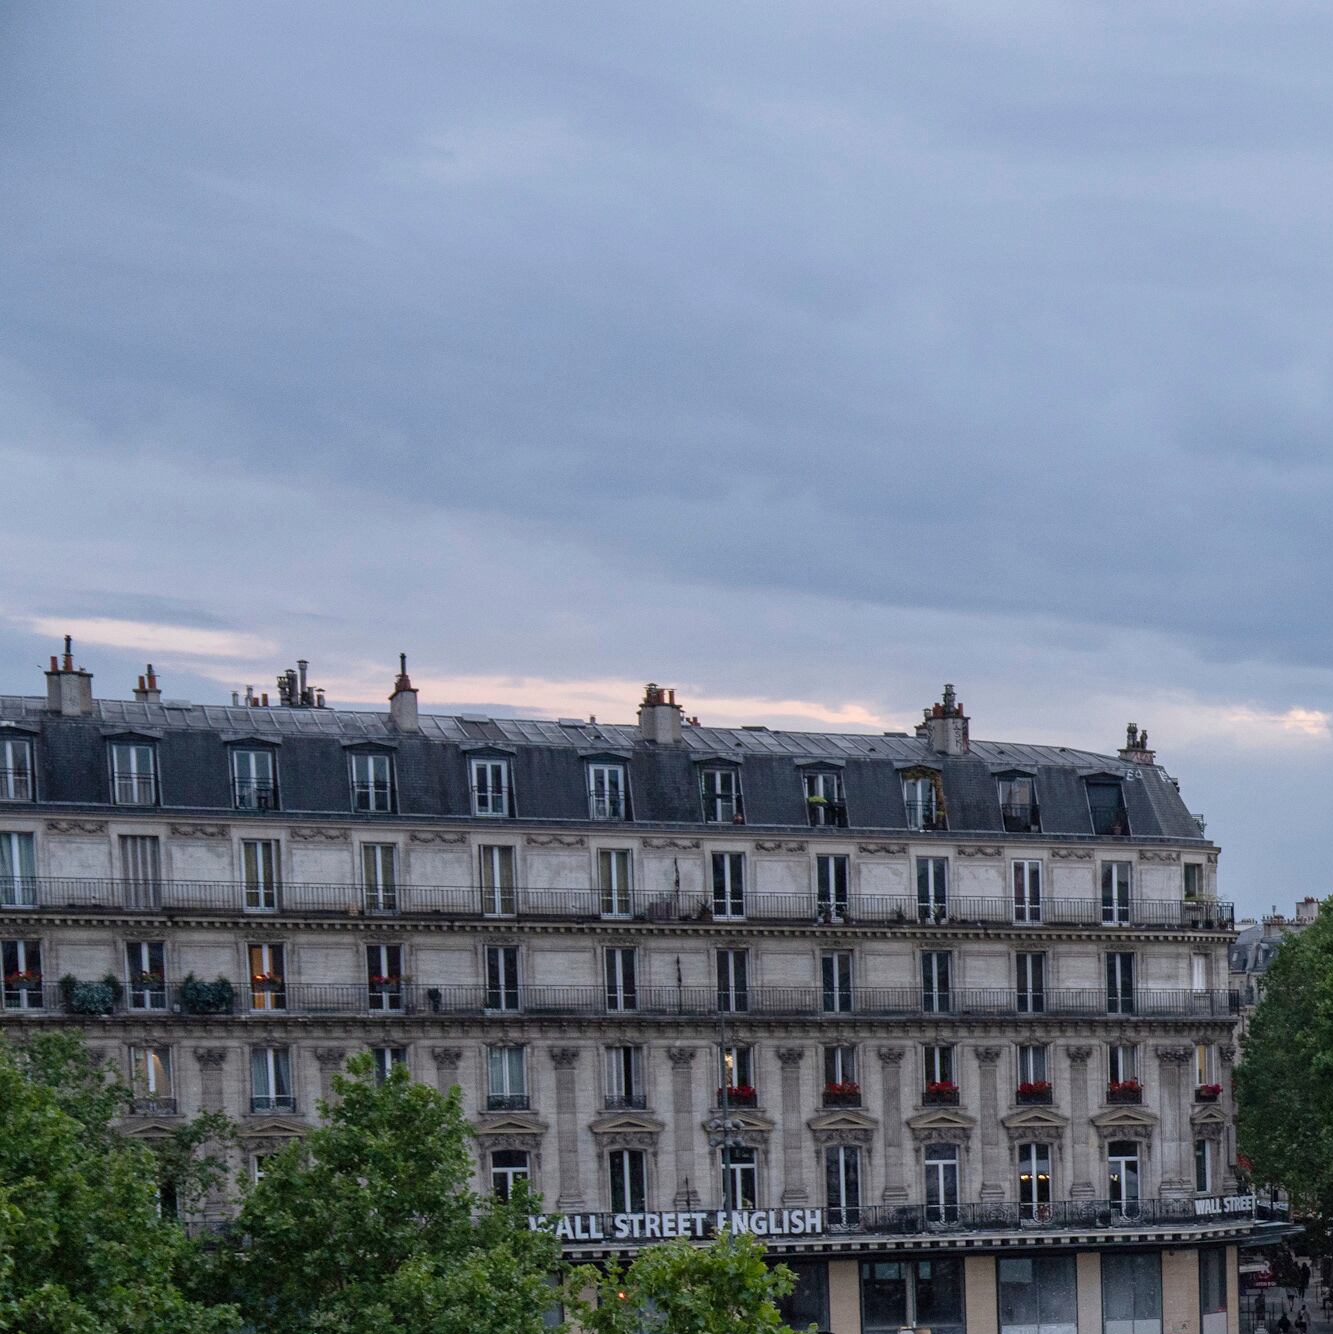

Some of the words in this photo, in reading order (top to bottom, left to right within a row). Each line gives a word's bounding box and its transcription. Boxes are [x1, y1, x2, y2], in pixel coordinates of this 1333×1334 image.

[1195, 1198, 1222, 1215] WALL
[1224, 1195, 1256, 1212] STREET
[615, 1211, 707, 1238] STREET
[717, 1209, 822, 1236] ENGLISH
